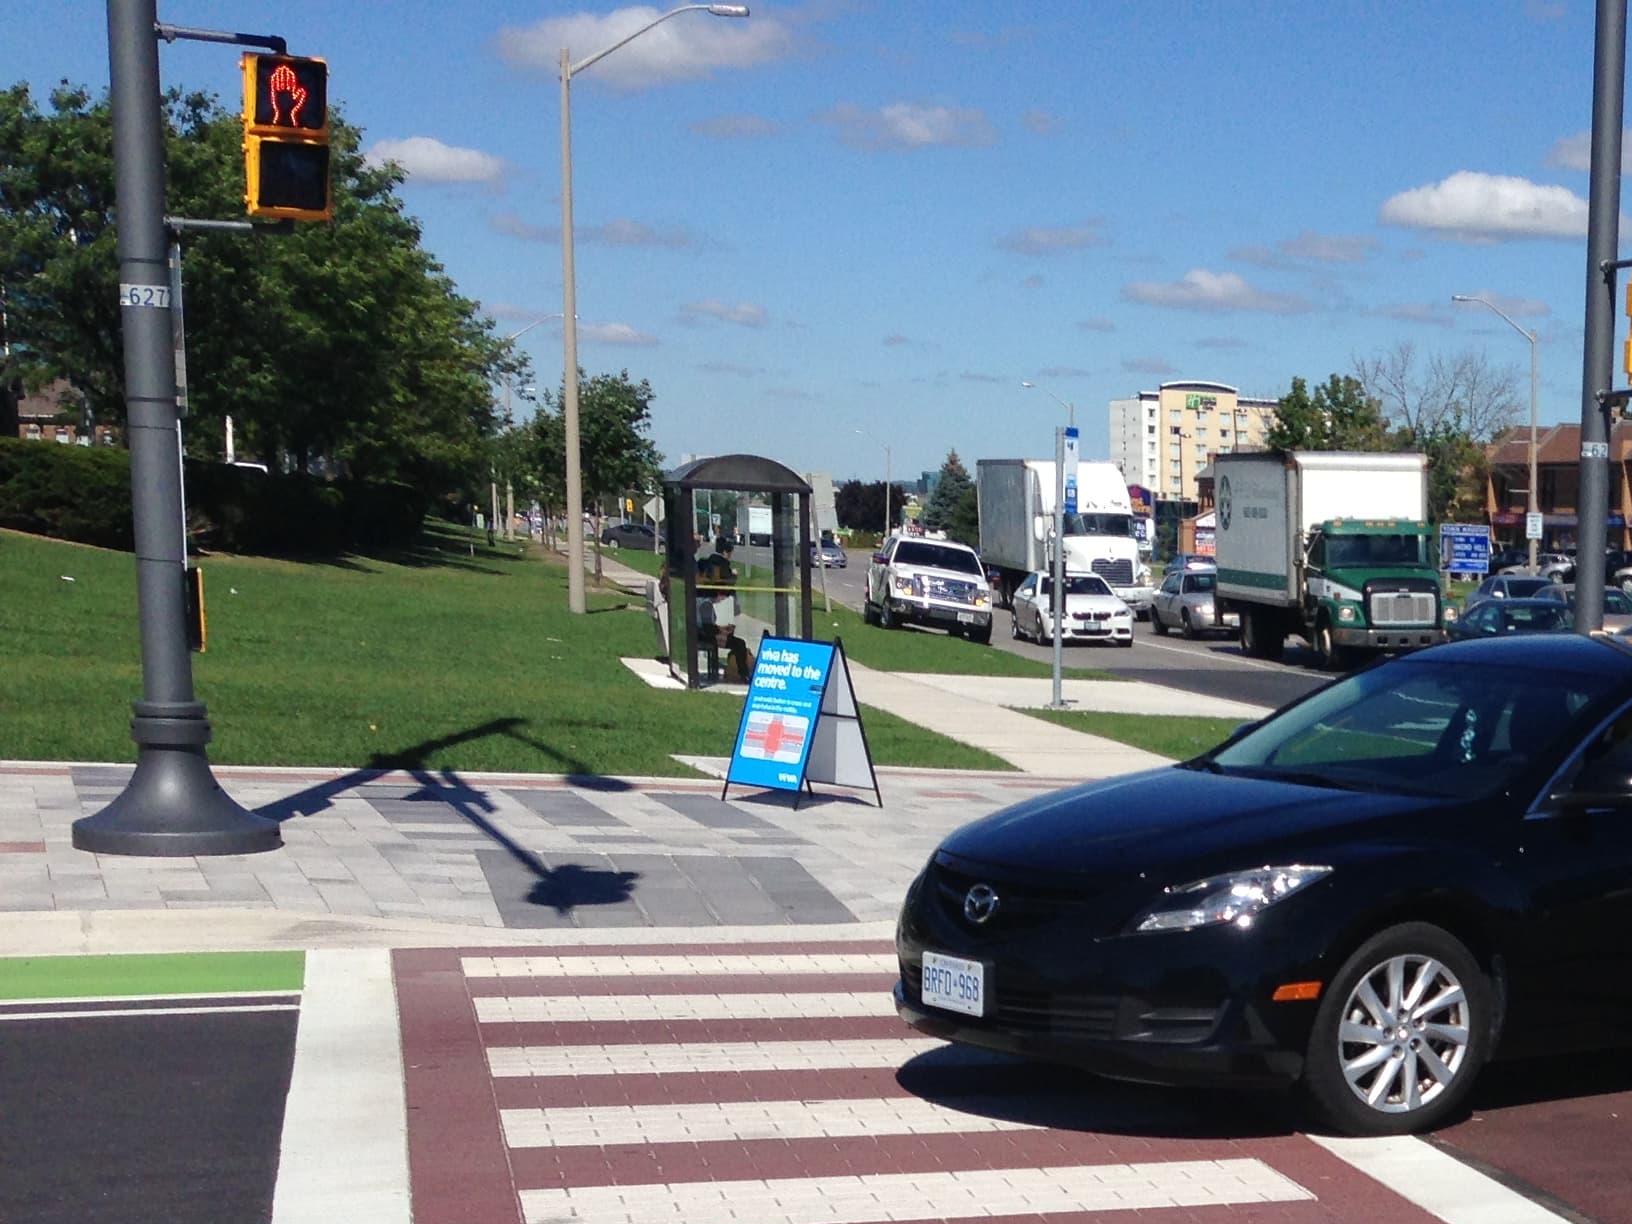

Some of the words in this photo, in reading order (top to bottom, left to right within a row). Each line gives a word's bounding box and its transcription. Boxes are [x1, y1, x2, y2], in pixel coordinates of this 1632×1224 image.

[761, 648, 782, 661] viva
[782, 649, 799, 663] has
[757, 662, 792, 676] moved
[792, 666, 801, 677] to
[804, 665, 821, 680] the
[754, 676, 787, 690] centre.
